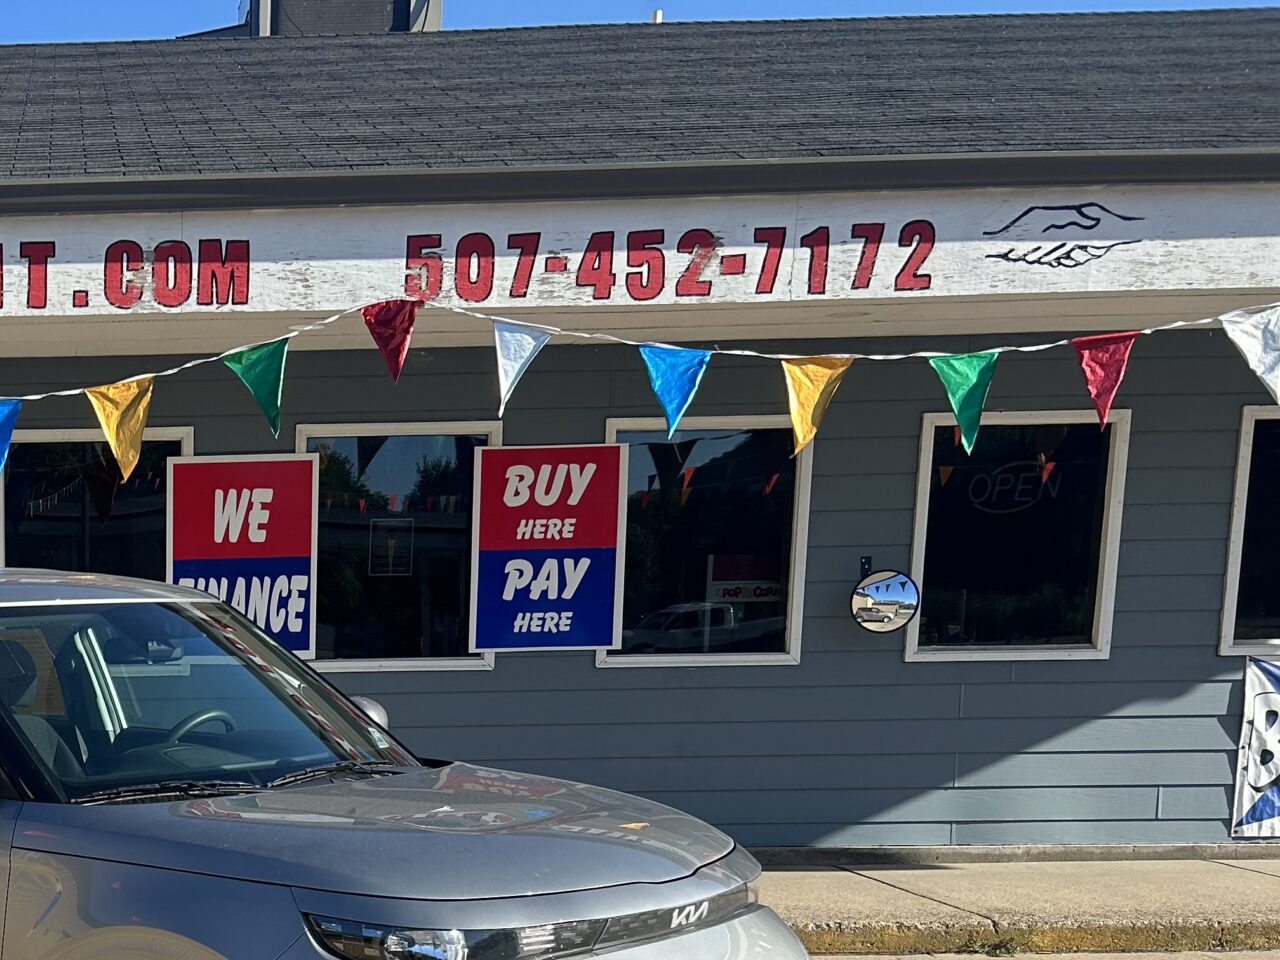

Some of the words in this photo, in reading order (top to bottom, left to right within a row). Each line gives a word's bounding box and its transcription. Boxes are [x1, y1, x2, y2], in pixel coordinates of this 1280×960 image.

[405, 219, 935, 301] 507-452-7172
[503, 463, 597, 507] BUY
[968, 472, 1062, 502] OPEN
[213, 488, 273, 543] WE
[516, 518, 576, 540] HERE
[502, 557, 591, 601] PAY
[178, 575, 309, 633] ANCE
[513, 612, 573, 634] HERE
[670, 901, 709, 928] KIA
